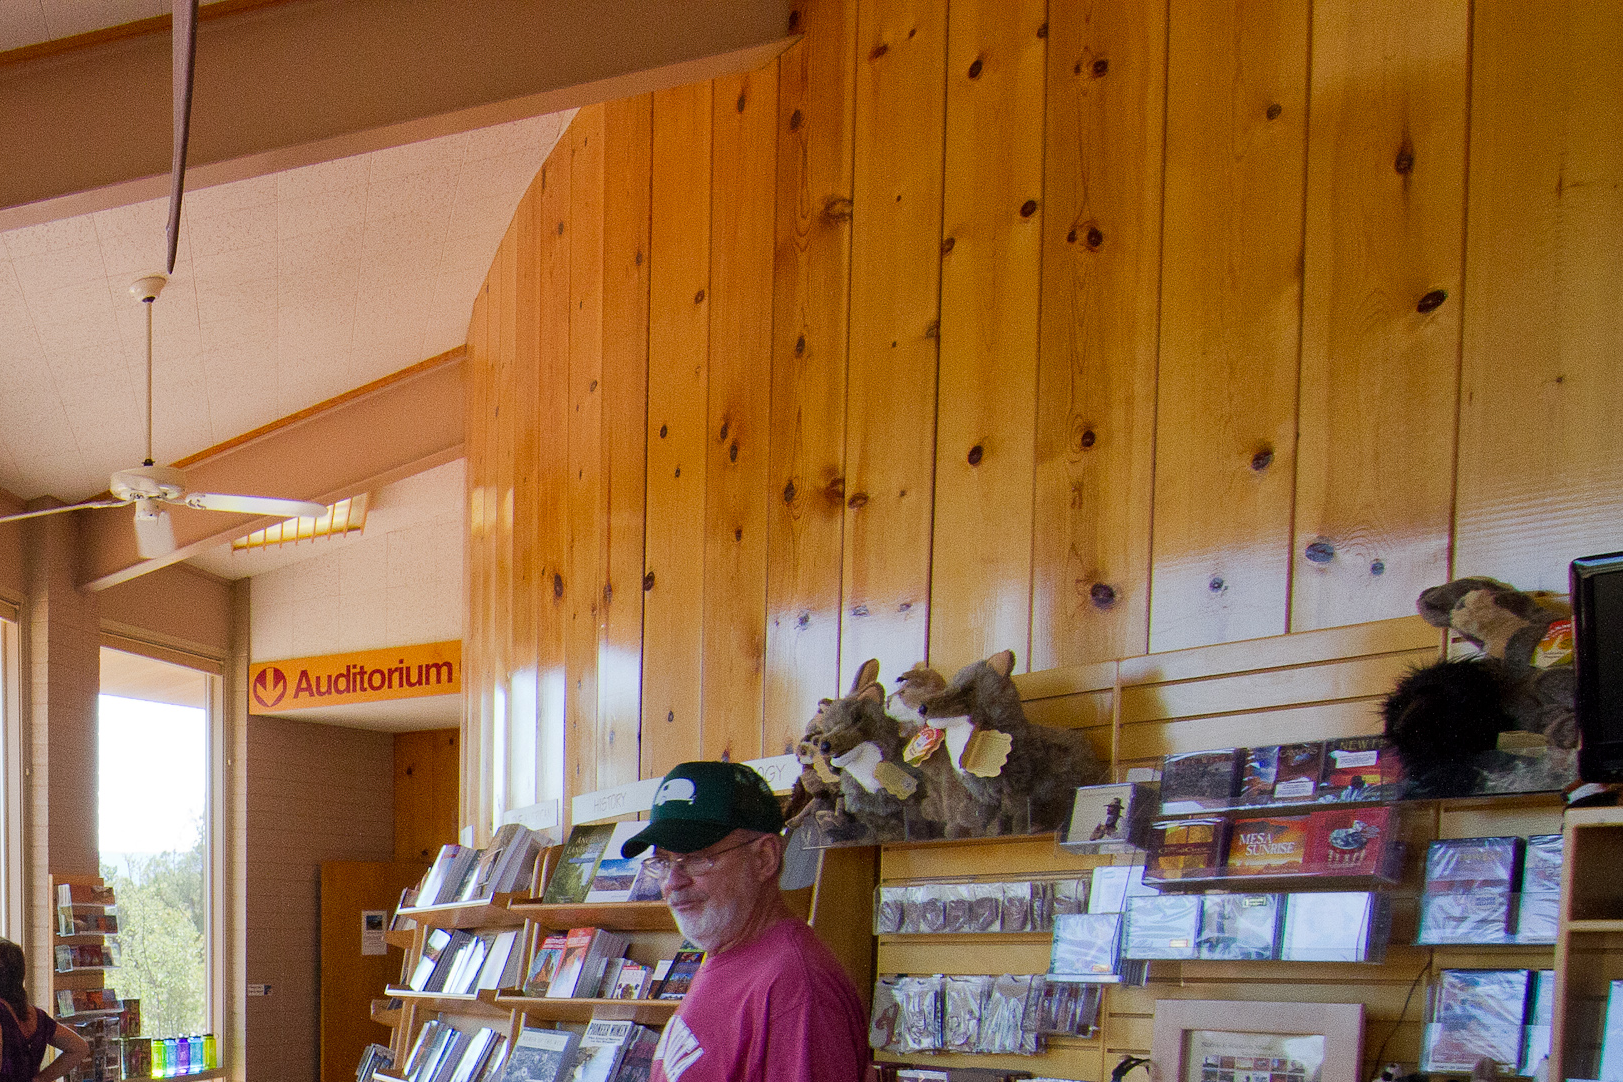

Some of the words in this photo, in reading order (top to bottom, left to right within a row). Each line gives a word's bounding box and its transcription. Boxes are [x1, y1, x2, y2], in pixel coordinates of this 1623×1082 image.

[293, 659, 453, 699] Auditorium
[594, 792, 628, 813] HISTORY
[1239, 833, 1273, 846] MESA
[1245, 842, 1295, 856] SUNRISE
